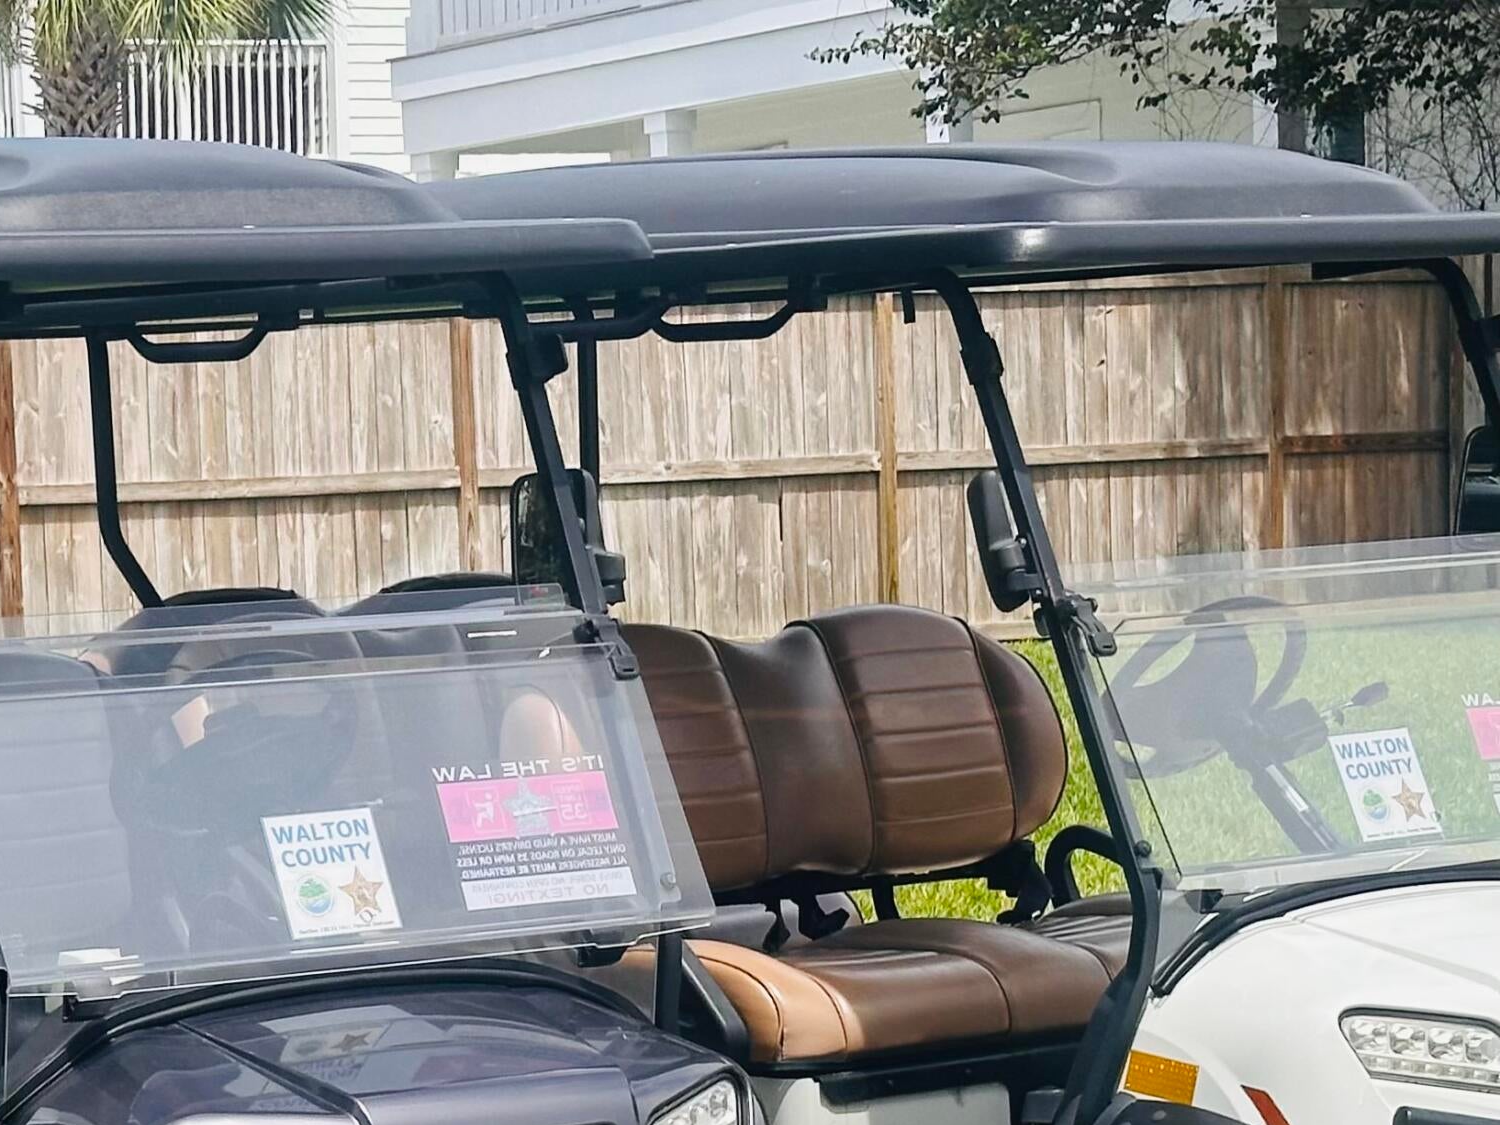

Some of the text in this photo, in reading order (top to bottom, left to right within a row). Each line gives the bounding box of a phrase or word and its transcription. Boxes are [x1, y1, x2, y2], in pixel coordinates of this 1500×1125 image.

[1335, 737, 1410, 760] WALTON
[1345, 757, 1412, 780] COUNTY
[271, 818, 370, 845] WALTON
[281, 842, 371, 868] COUNTY
